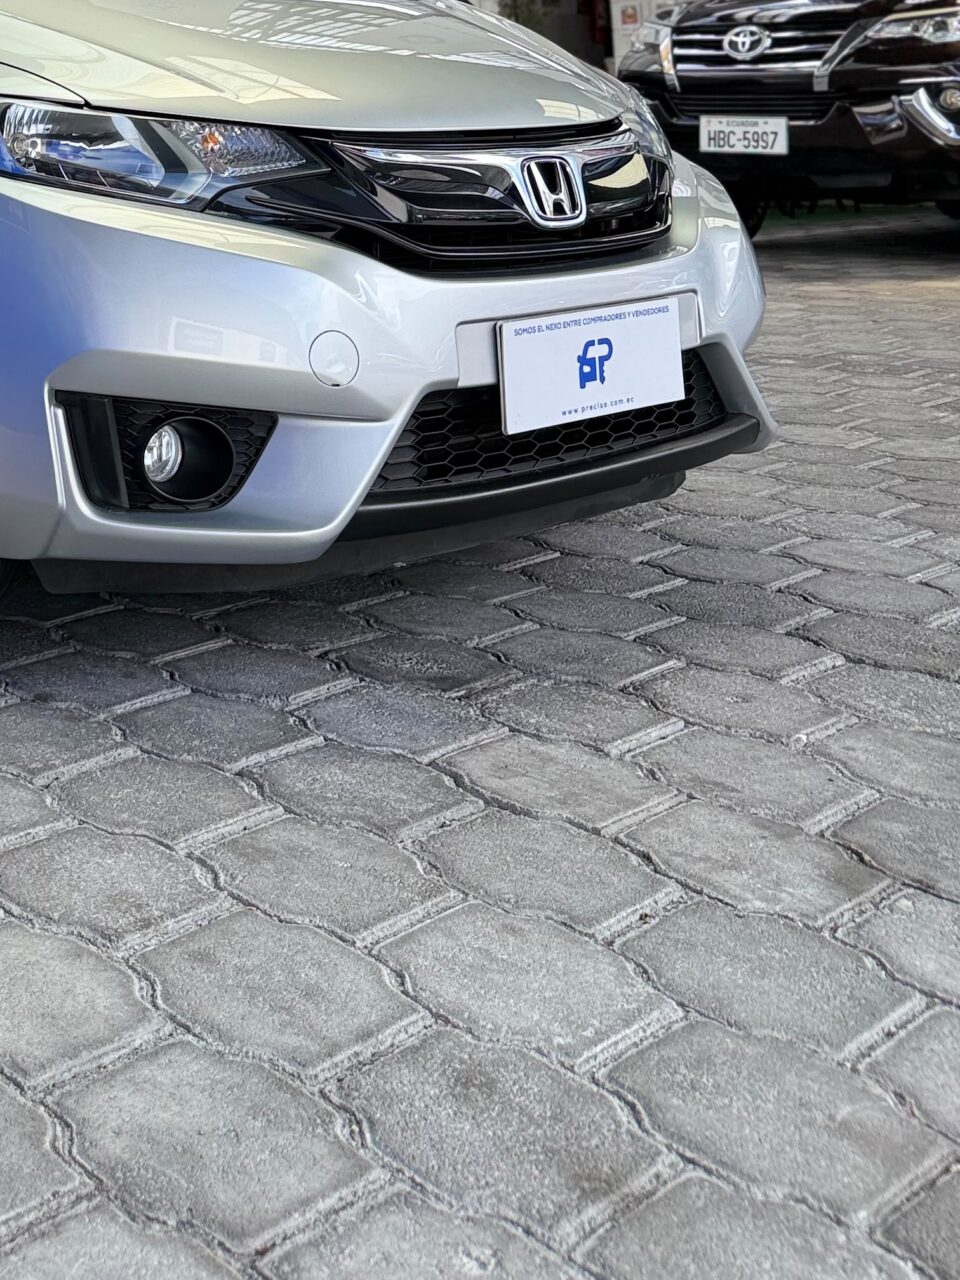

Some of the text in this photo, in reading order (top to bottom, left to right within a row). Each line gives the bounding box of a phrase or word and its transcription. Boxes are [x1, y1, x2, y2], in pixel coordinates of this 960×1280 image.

[514, 325, 537, 336] SOMOS
[537, 324, 545, 333] EL
[545, 321, 562, 331] NEXO
[563, 318, 582, 329] ENTRE
[583, 312, 627, 325] COMPRADORES
[632, 305, 670, 318] VENDEDORES
